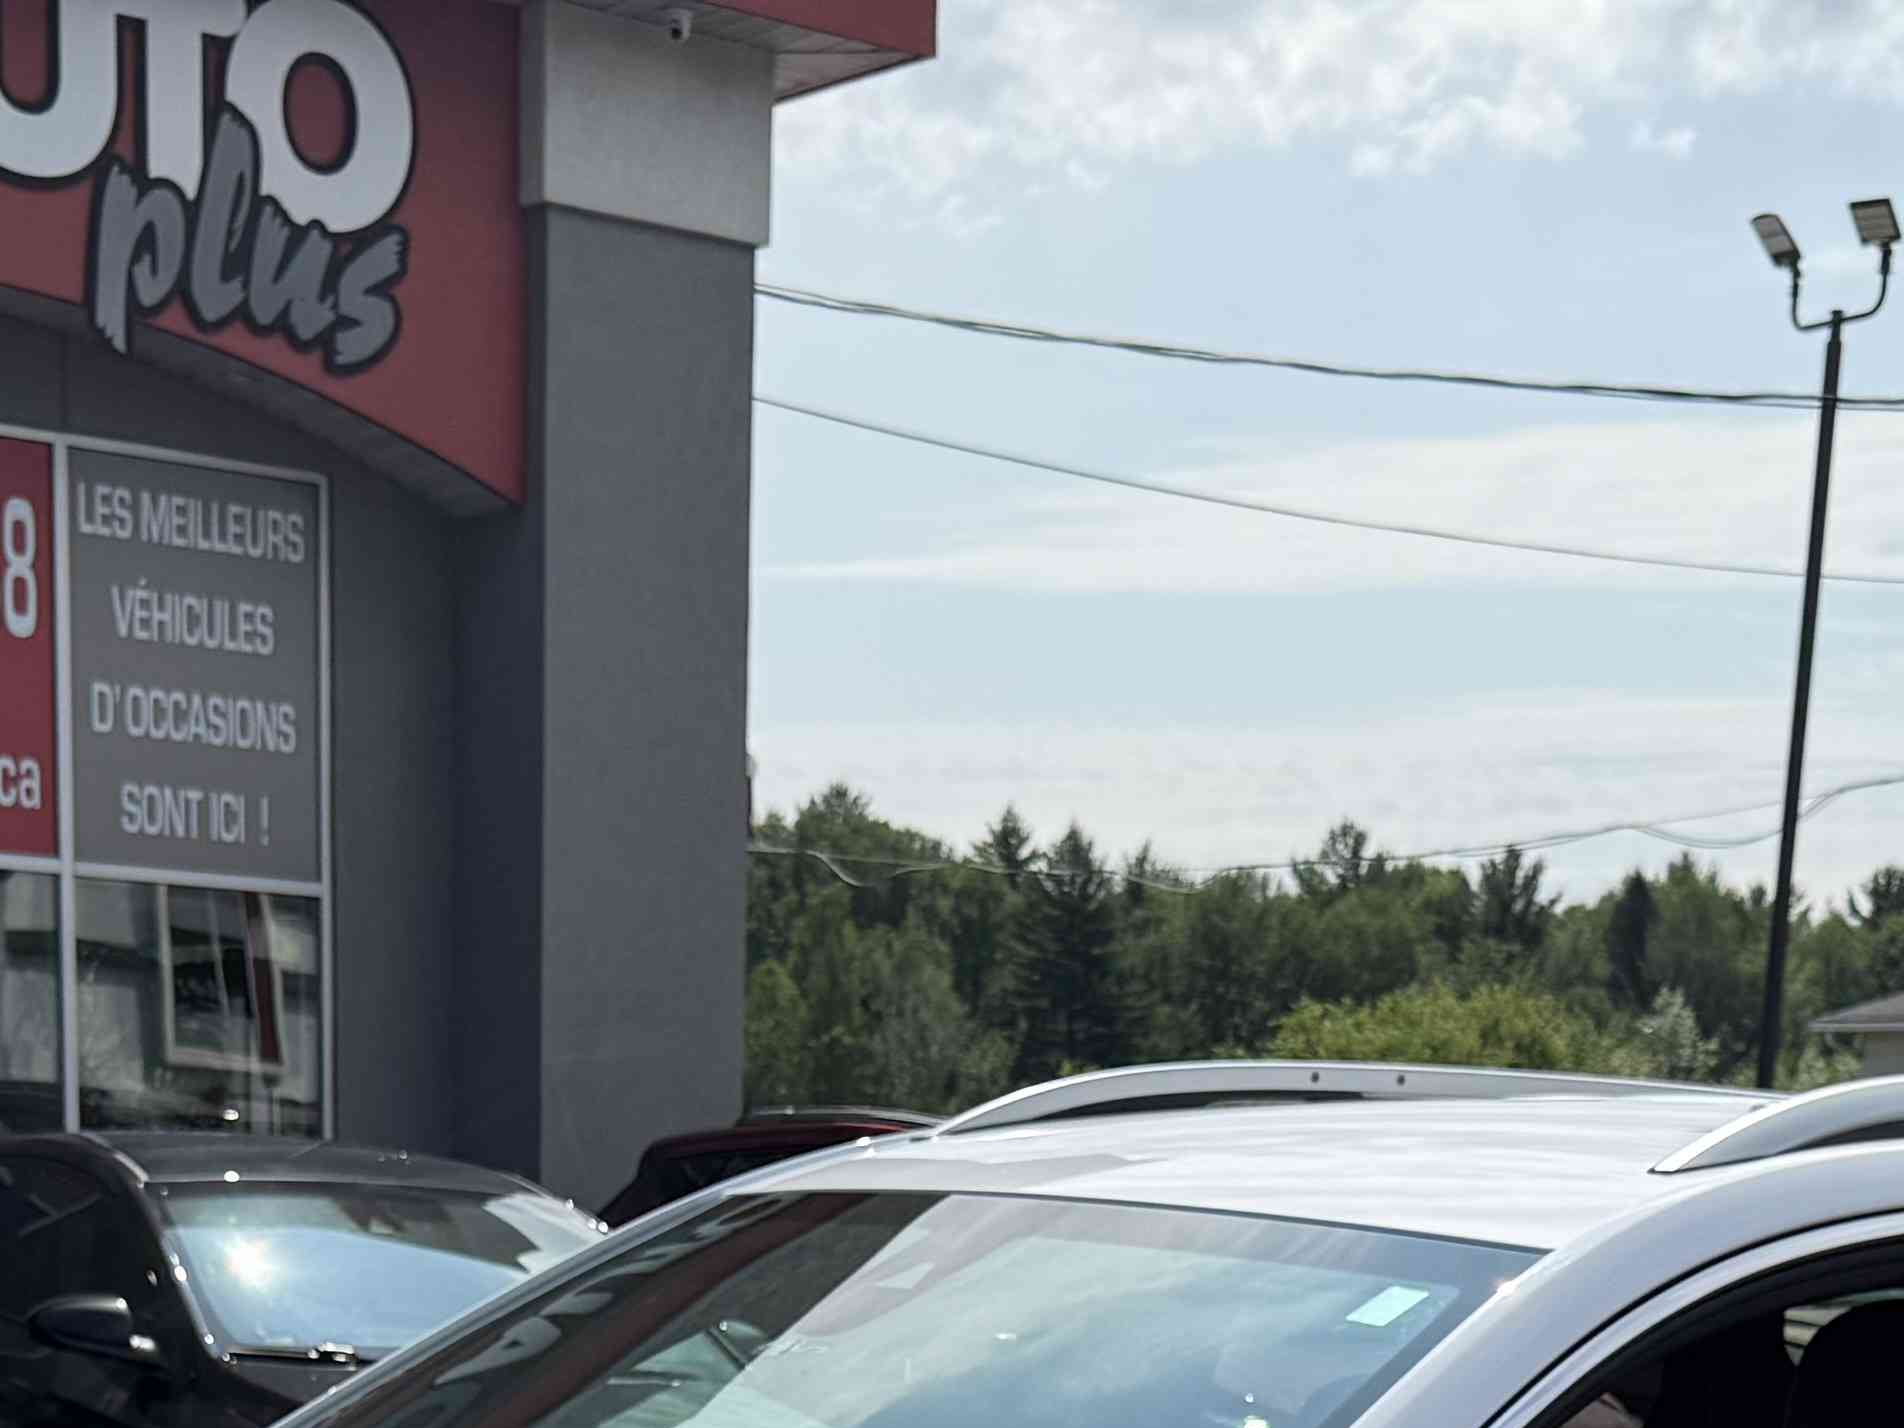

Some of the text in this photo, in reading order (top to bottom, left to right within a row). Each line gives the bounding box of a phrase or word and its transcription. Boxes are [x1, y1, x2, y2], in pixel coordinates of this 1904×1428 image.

[97, 106, 407, 366] plus
[76, 481, 305, 563] LES MEILLEURS
[110, 577, 275, 656] VÉHICULES
[119, 781, 204, 840] SONT
